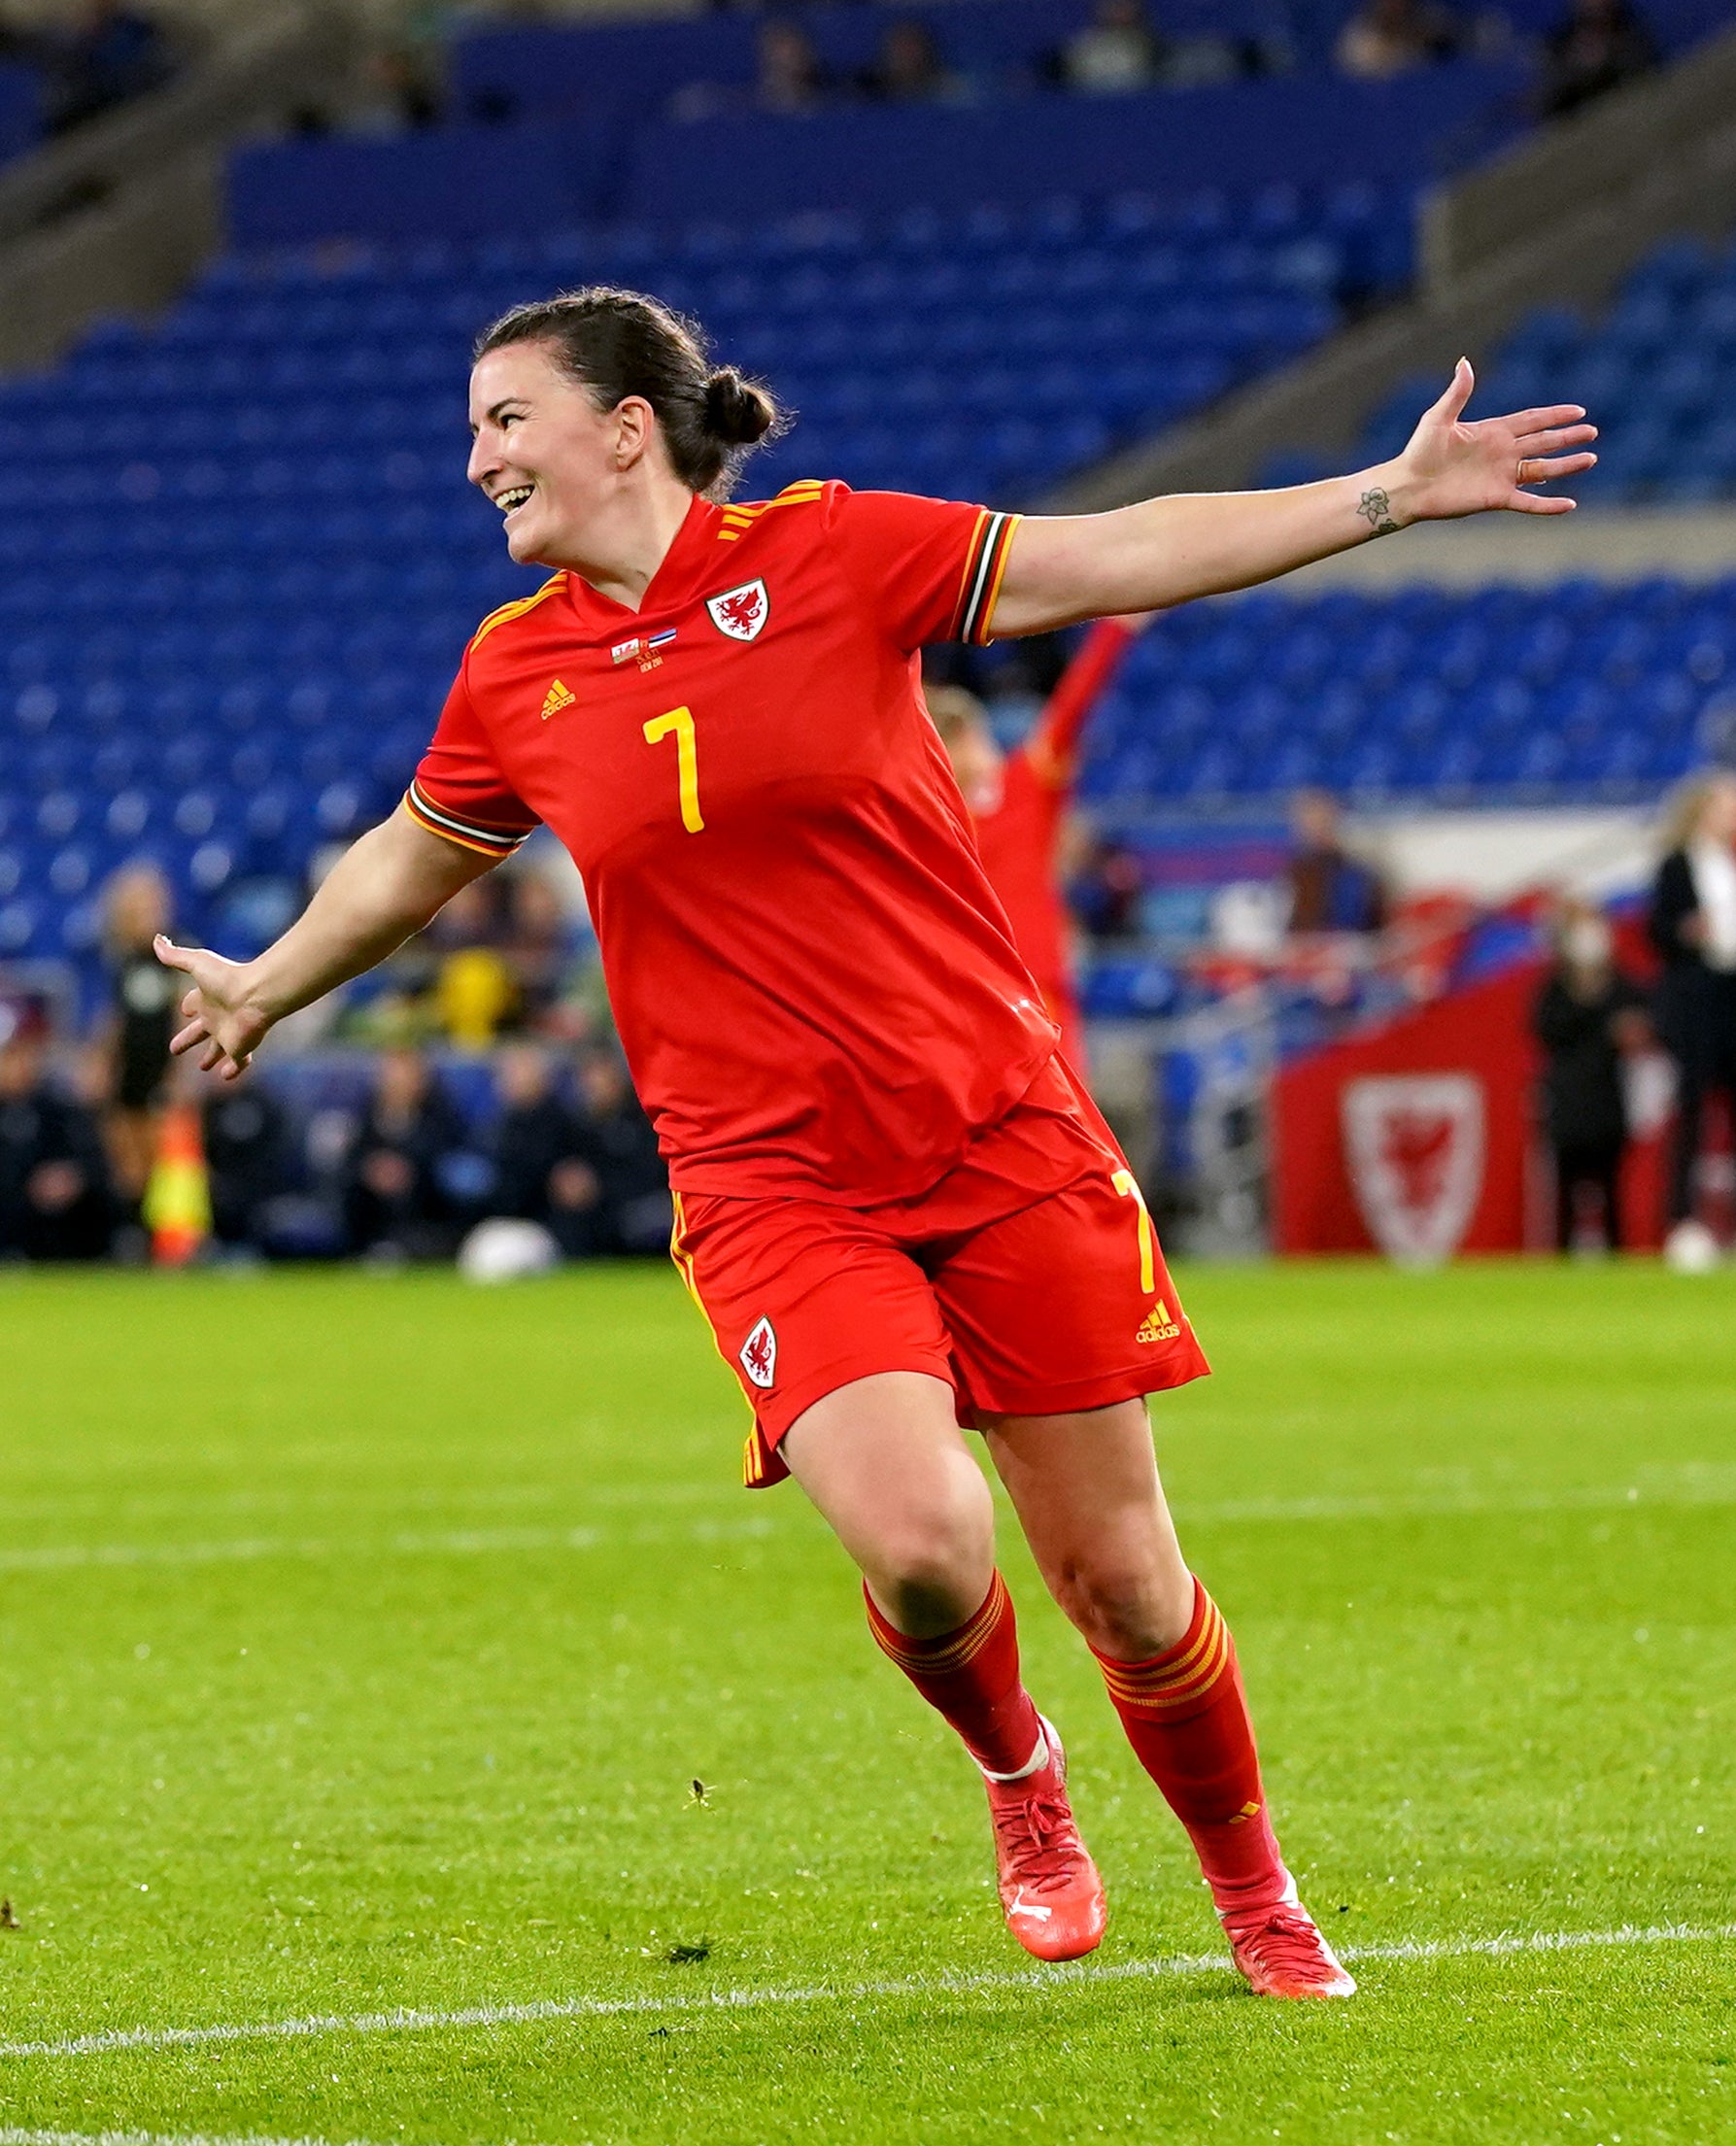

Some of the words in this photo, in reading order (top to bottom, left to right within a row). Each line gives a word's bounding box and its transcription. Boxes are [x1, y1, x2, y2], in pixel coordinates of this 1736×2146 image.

[541, 693, 576, 721] adidas
[642, 705, 705, 834] 7
[1110, 1169, 1155, 1294] 7
[1136, 1324, 1180, 1344] adidas
